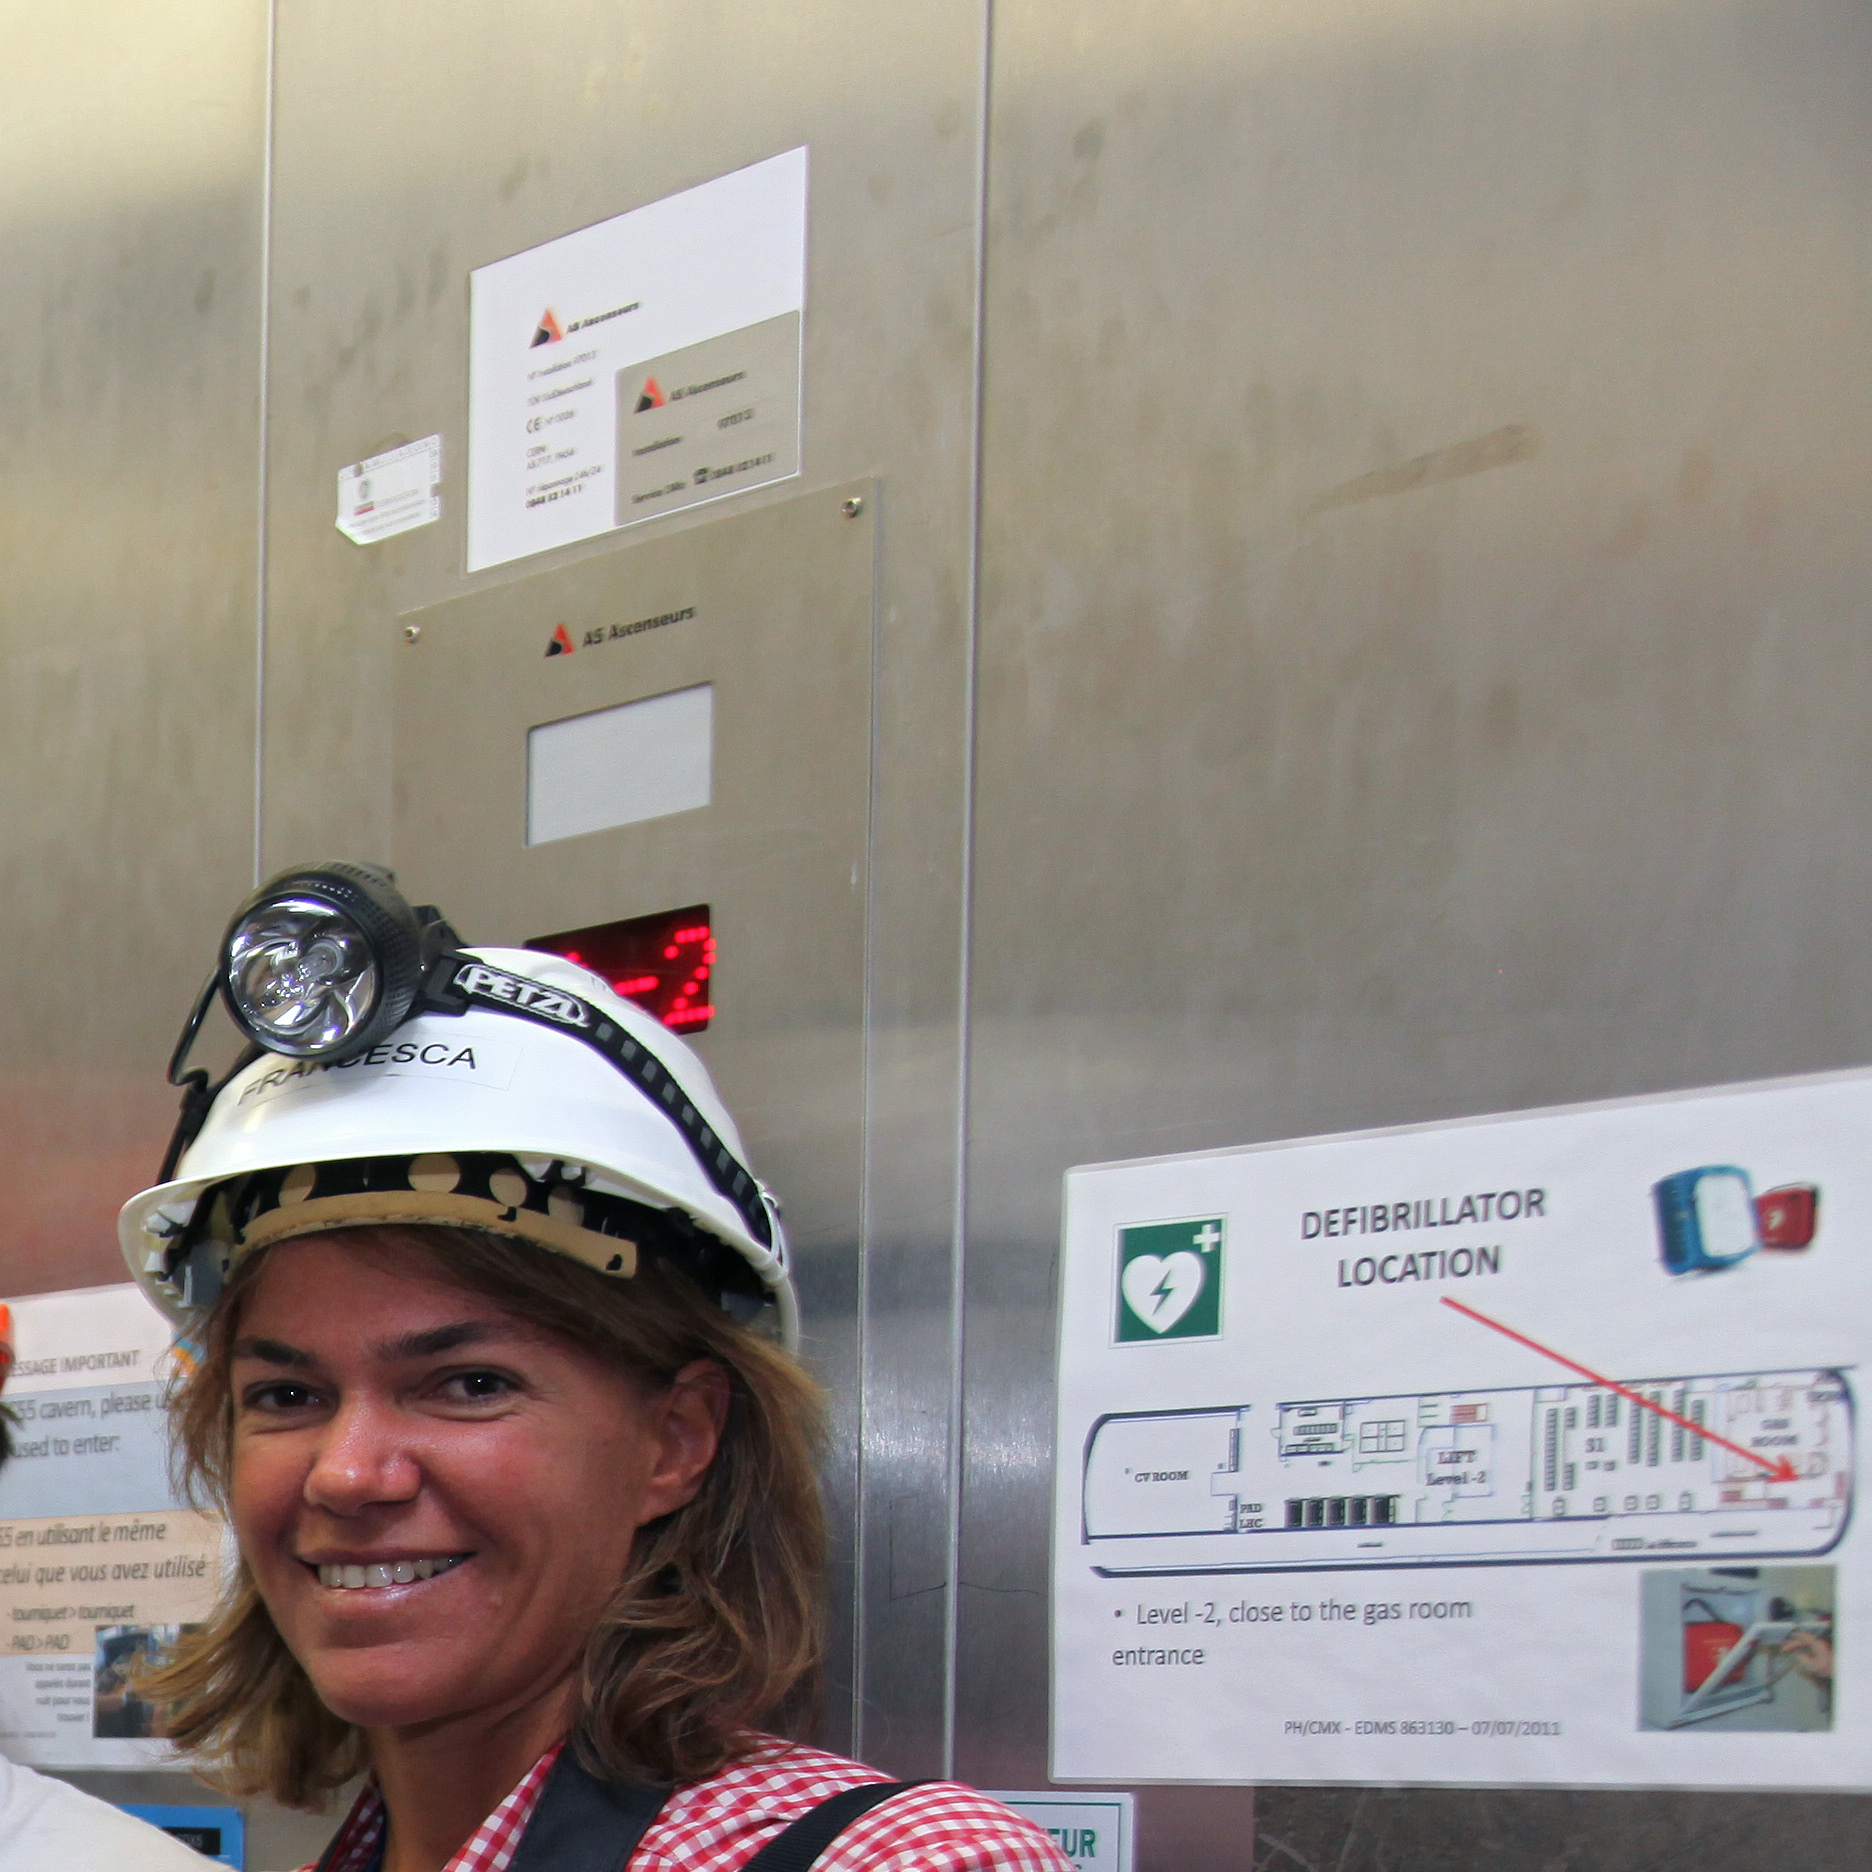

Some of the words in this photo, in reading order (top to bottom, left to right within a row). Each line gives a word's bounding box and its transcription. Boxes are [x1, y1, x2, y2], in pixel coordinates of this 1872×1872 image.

[583, 626, 605, 648] AS
[608, 605, 697, 641] Ascenseurs
[464, 964, 580, 1024] PETZL
[1300, 1187, 1546, 1241] DEFIBRILLATOR
[1336, 1245, 1501, 1289] LOCATION
[59, 1350, 140, 1372] IMPORTANT
[40, 1398, 96, 1420] cavern,
[100, 1391, 153, 1421] please
[53, 1435, 70, 1456] to
[1437, 1449, 1477, 1465] LIFT
[1134, 1472, 1151, 1483] CV
[1152, 1469, 1189, 1482] ROOM
[1426, 1471, 1470, 1487] Level
[1240, 1502, 1262, 1515] PAD
[15, 1530, 35, 1547] en
[38, 1523, 96, 1546] utilisant
[97, 1520, 112, 1544] le
[113, 1519, 167, 1542] même
[1239, 1517, 1263, 1529] LHC
[35, 1565, 65, 1588] que
[70, 1564, 107, 1582] vous
[111, 1562, 150, 1582] avez
[155, 1551, 207, 1579] utilisé
[1136, 1601, 1189, 1626] Level
[1194, 1601, 1222, 1628] -2,
[1228, 1599, 1284, 1624] close
[1289, 1602, 1313, 1623] to
[1319, 1598, 1357, 1622] the
[1362, 1601, 1402, 1627] gas
[1408, 1599, 1473, 1621] room
[1111, 1646, 1206, 1667] entrance
[1283, 1719, 1342, 1738] PH/CMX
[1354, 1719, 1397, 1737] EDMS
[1399, 1719, 1455, 1737] 863130
[1471, 1719, 1563, 1738] 07/07/2011
